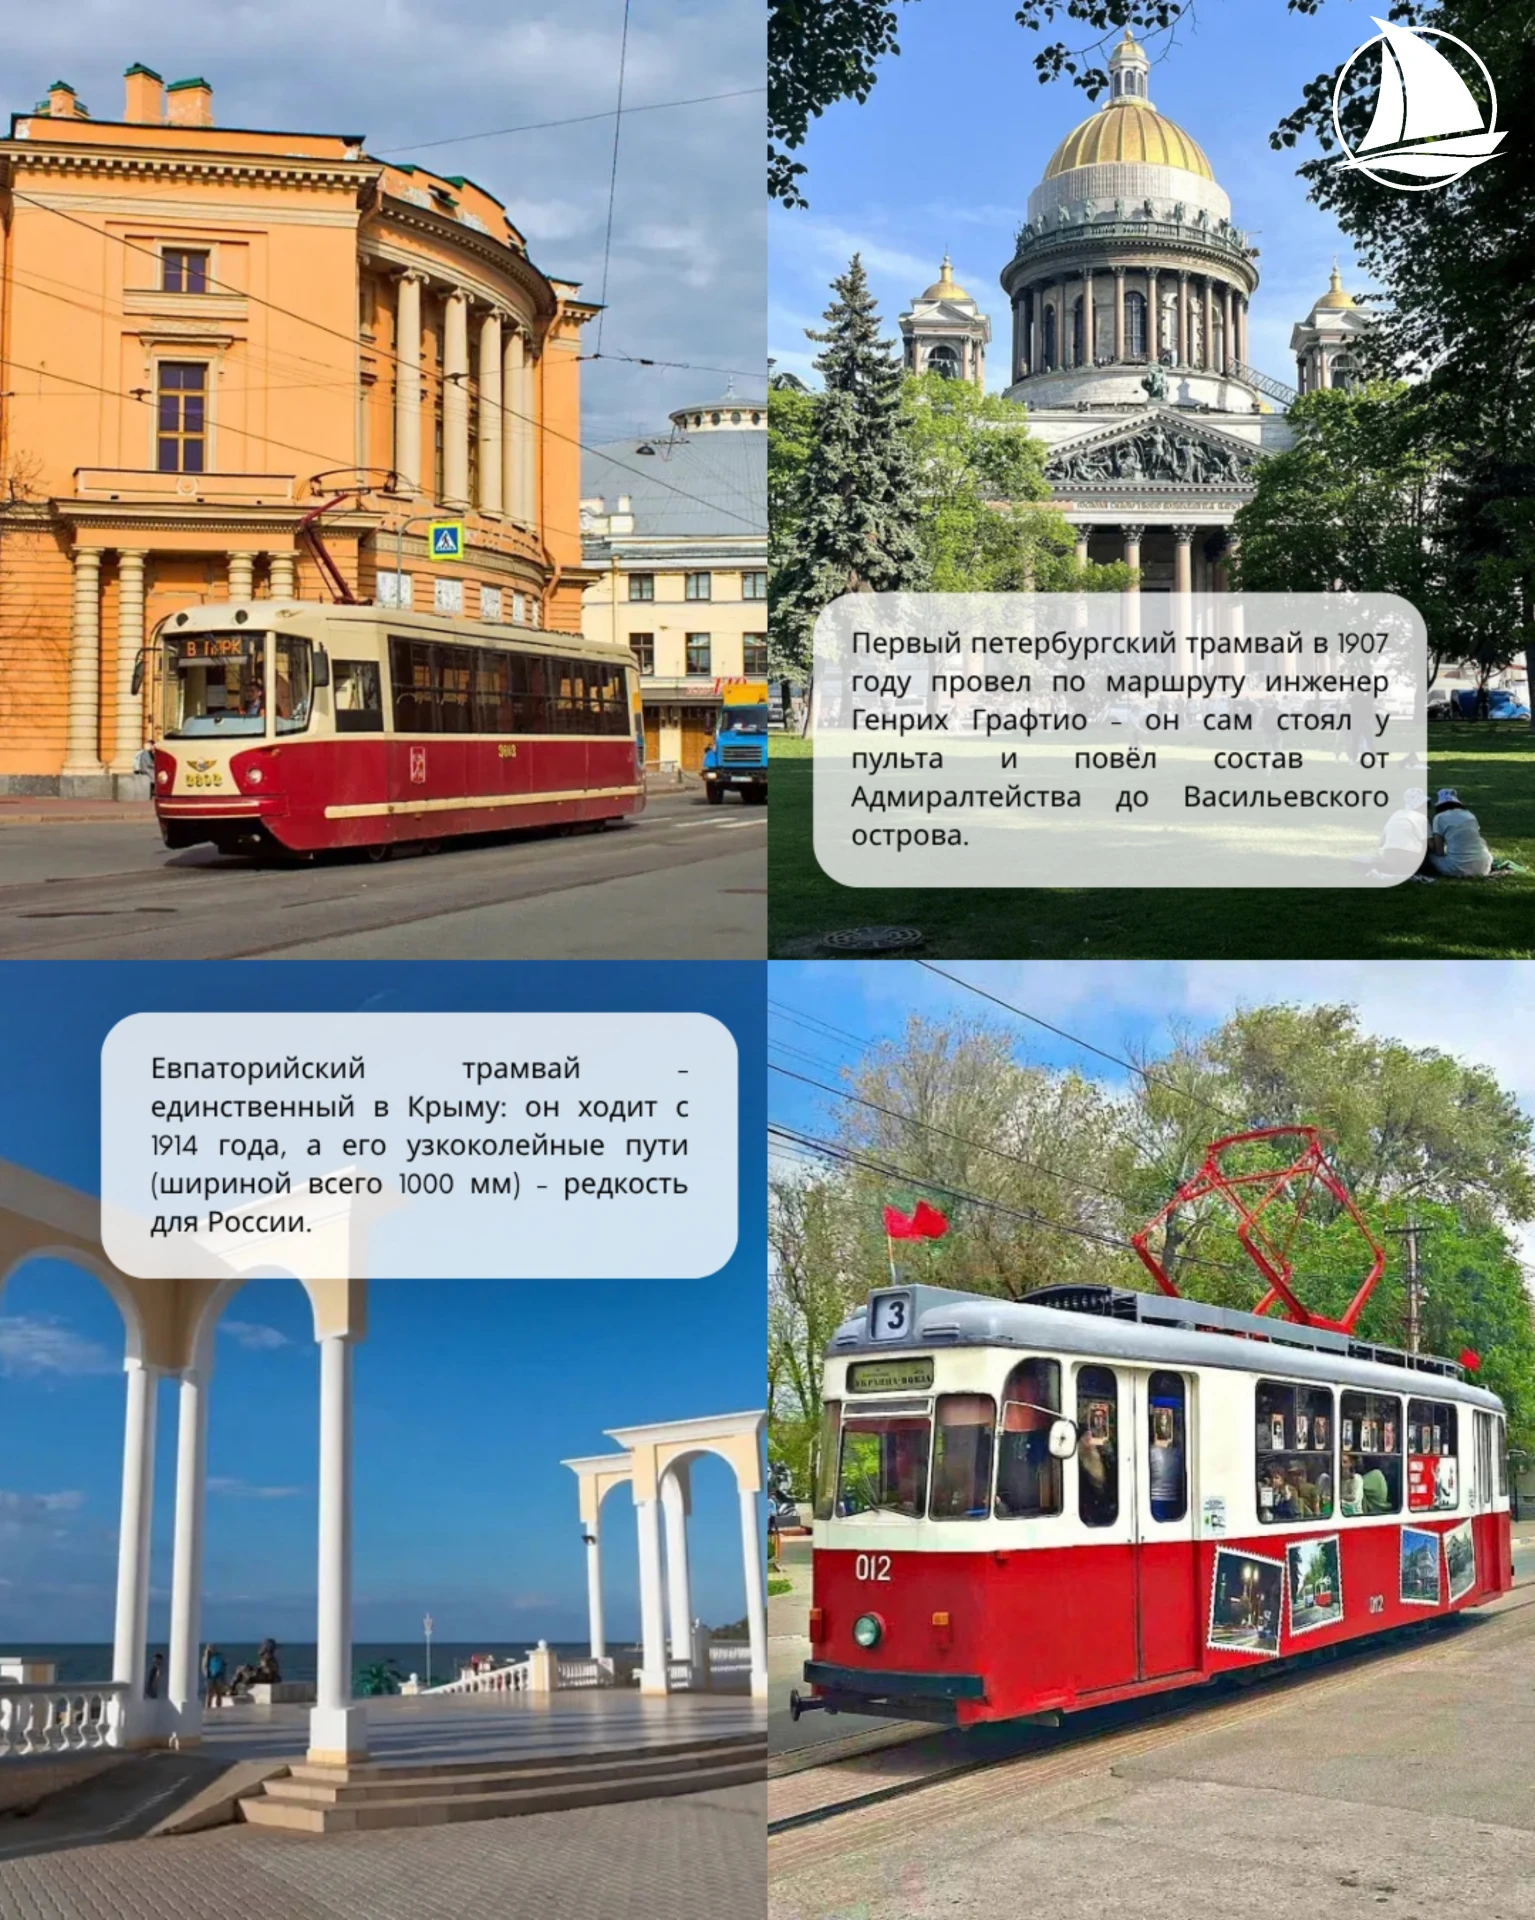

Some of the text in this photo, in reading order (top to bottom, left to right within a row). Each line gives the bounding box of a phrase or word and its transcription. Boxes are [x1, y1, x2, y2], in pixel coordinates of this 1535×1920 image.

[887, 1301, 905, 1330] 3
[855, 1554, 892, 1581] 012
[1369, 1594, 1384, 1614] 012
